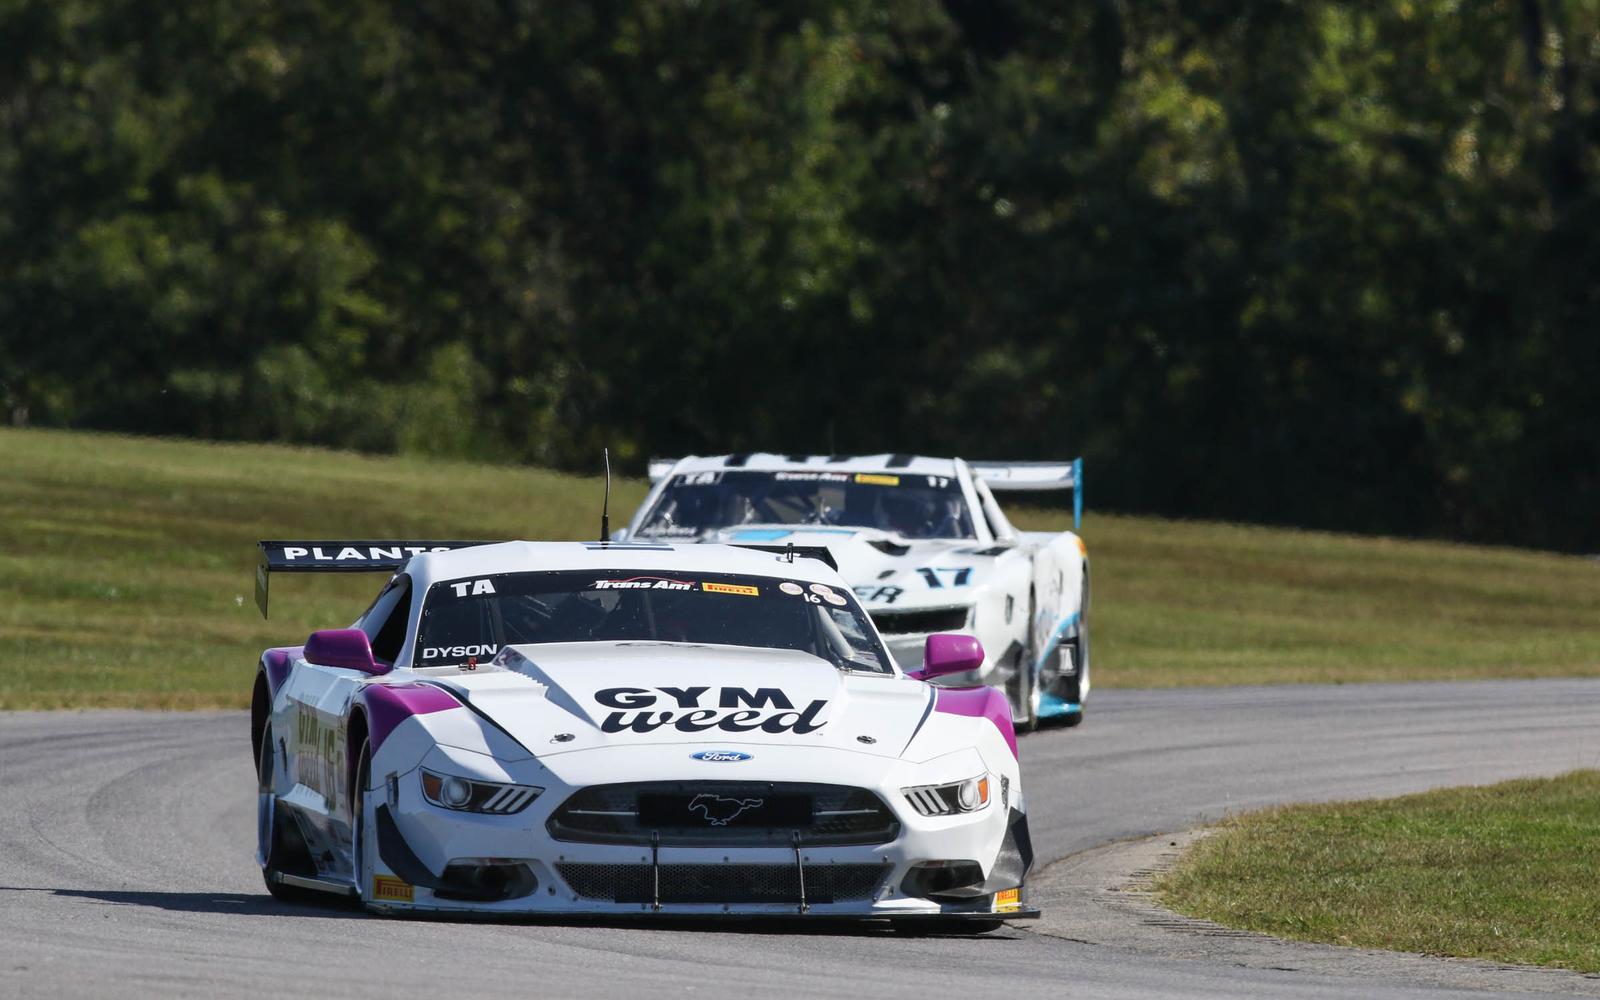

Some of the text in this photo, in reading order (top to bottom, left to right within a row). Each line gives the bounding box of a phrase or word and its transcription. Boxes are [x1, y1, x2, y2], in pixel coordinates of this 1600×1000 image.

[595, 580, 691, 590] Trans Am
[916, 567, 972, 588] 17
[451, 579, 496, 597] TA
[803, 593, 821, 604] 16
[422, 643, 498, 659] DYSON
[594, 686, 795, 709] GYM
[600, 699, 829, 735] weed
[702, 751, 741, 761] Ford
